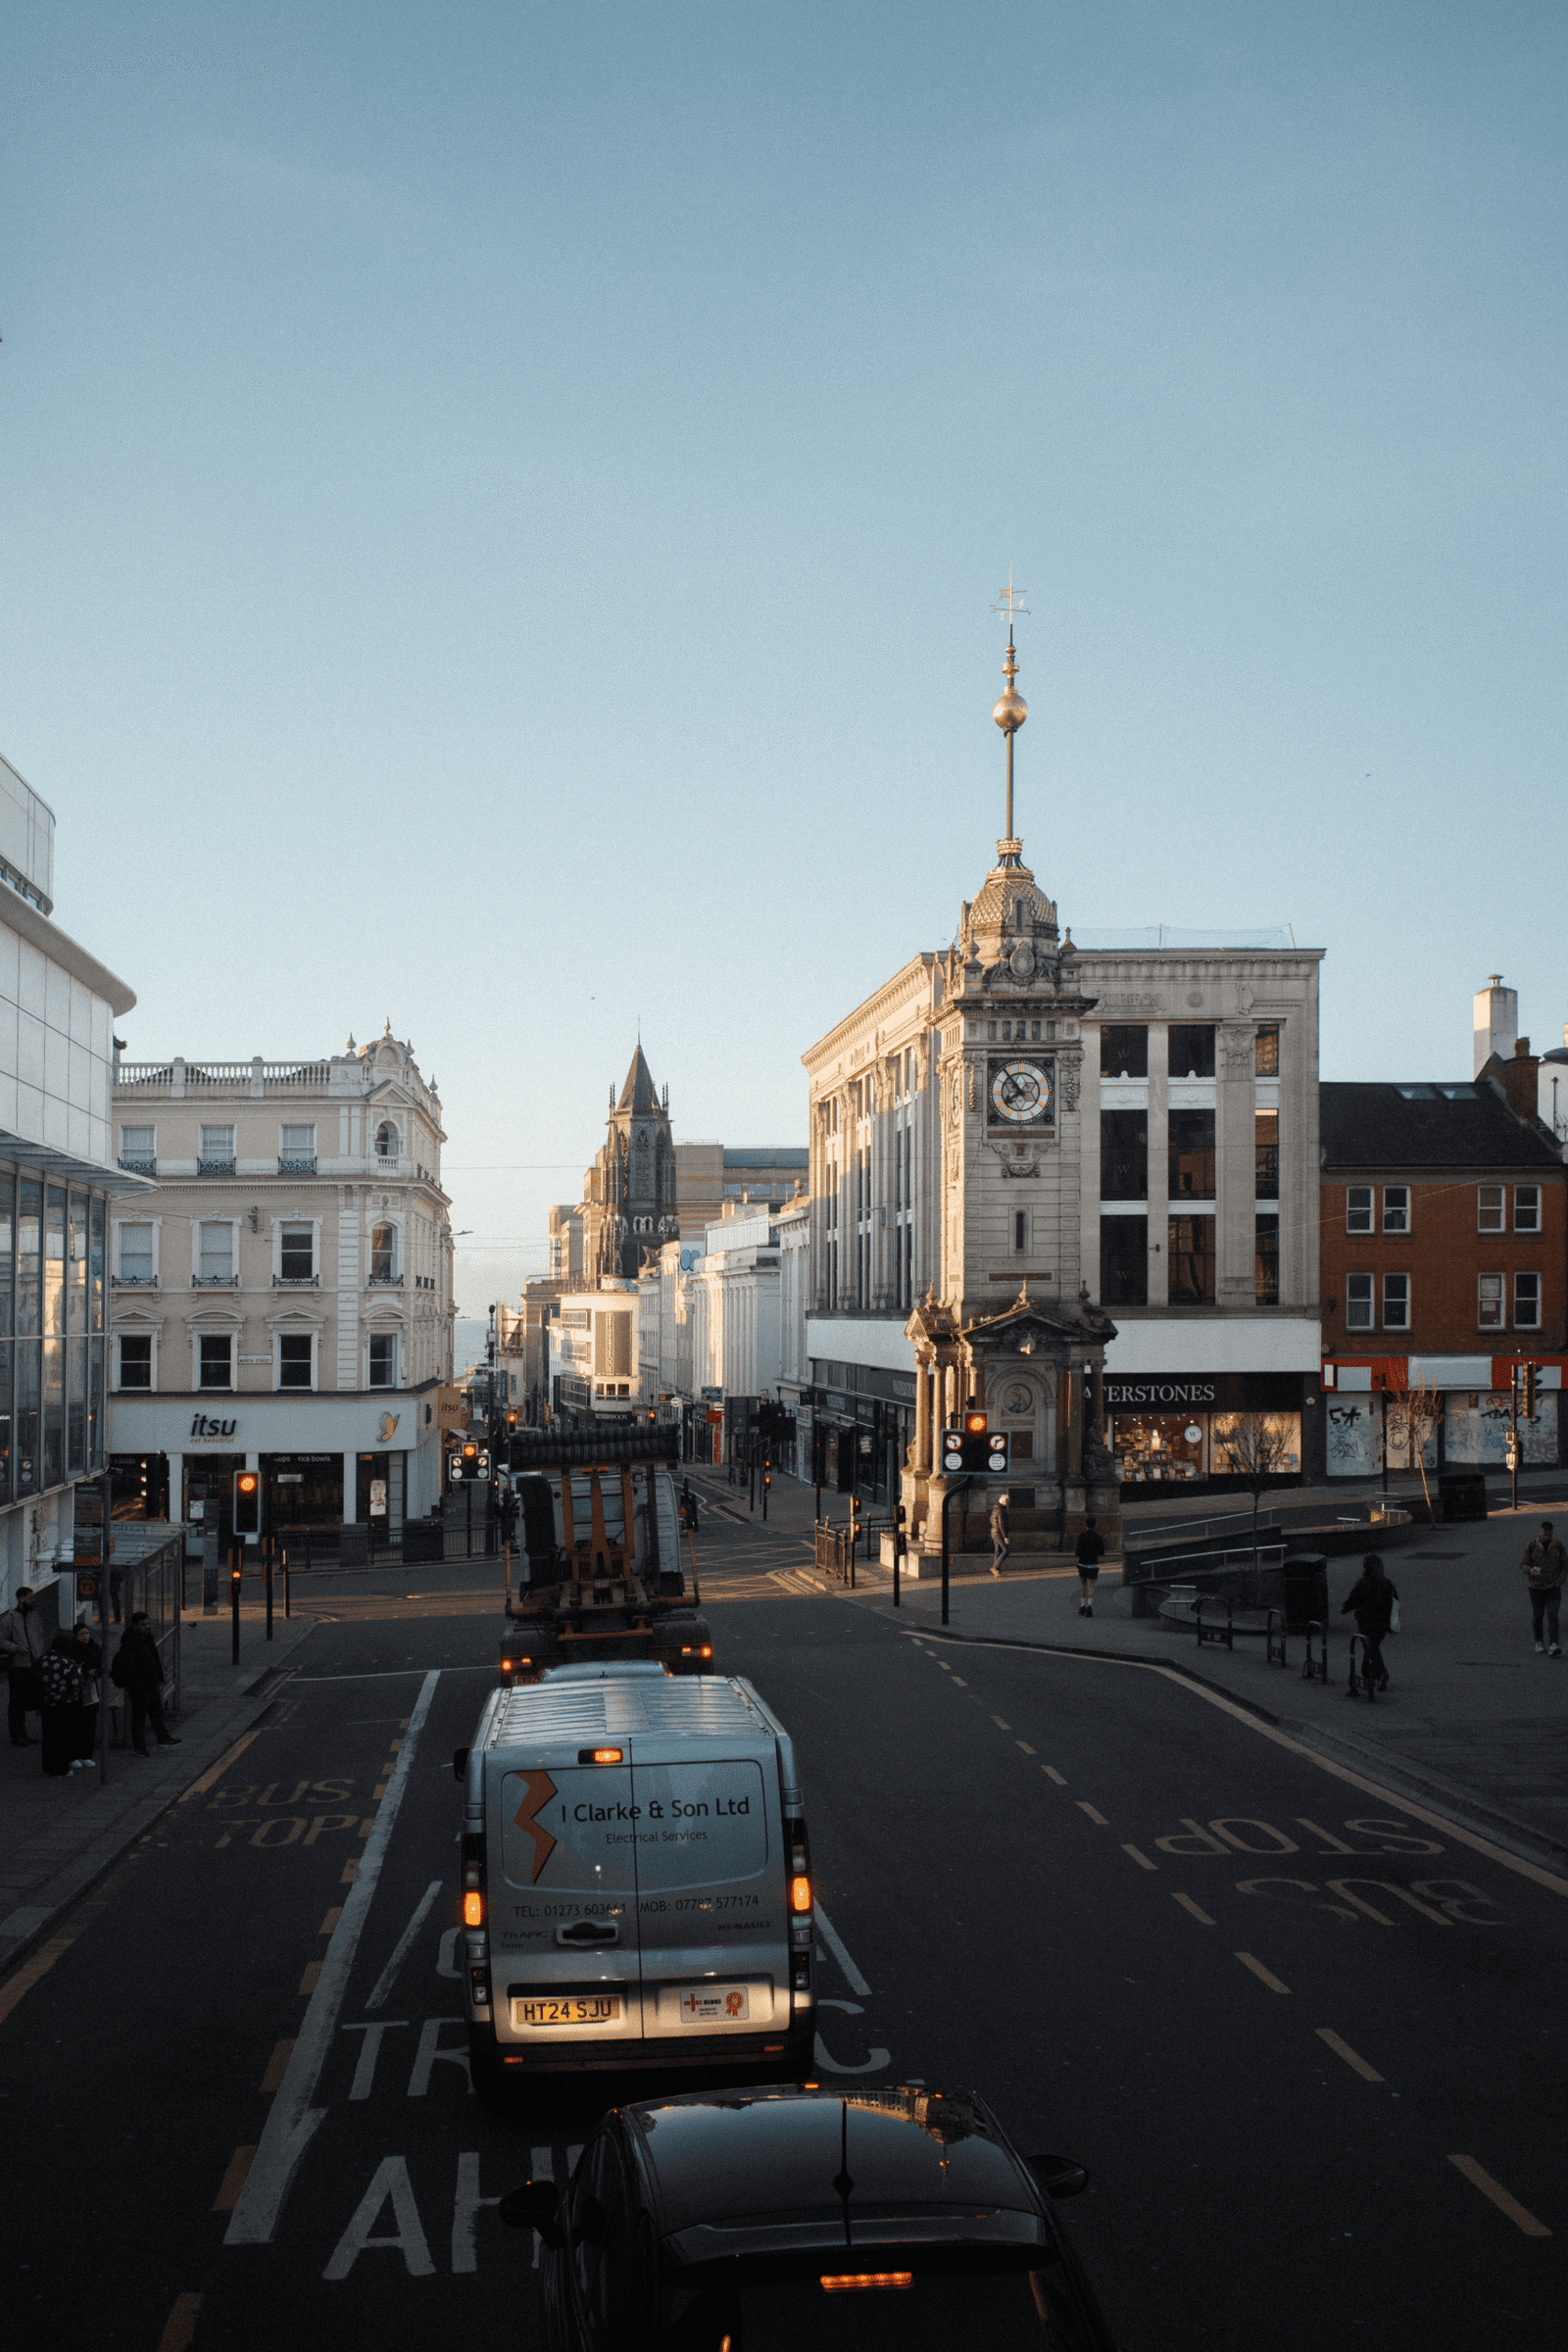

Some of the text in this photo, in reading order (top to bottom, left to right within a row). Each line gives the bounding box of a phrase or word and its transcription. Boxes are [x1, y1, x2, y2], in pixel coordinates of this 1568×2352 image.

[441, 1403, 459, 1412] itsu
[190, 1413, 237, 1437] itsu
[206, 1778, 356, 1809] BUS
[573, 1802, 642, 1822] Clarke
[649, 1800, 664, 1819] &
[671, 1799, 709, 1818] Son
[715, 1796, 750, 1816] Ltd
[606, 1830, 708, 1844] Electrical Services
[1154, 1817, 1446, 1855] STOP
[514, 1905, 540, 1918] TEL:
[544, 1904, 580, 1917] 01273
[640, 1900, 670, 1913] MOB:
[716, 1895, 759, 1909] 577174
[1235, 1878, 1511, 1927] BUS
[502, 1930, 549, 1939] TRAFIC
[717, 1920, 772, 1931] RENAULT
[524, 2000, 612, 2021] HT24 SJU
